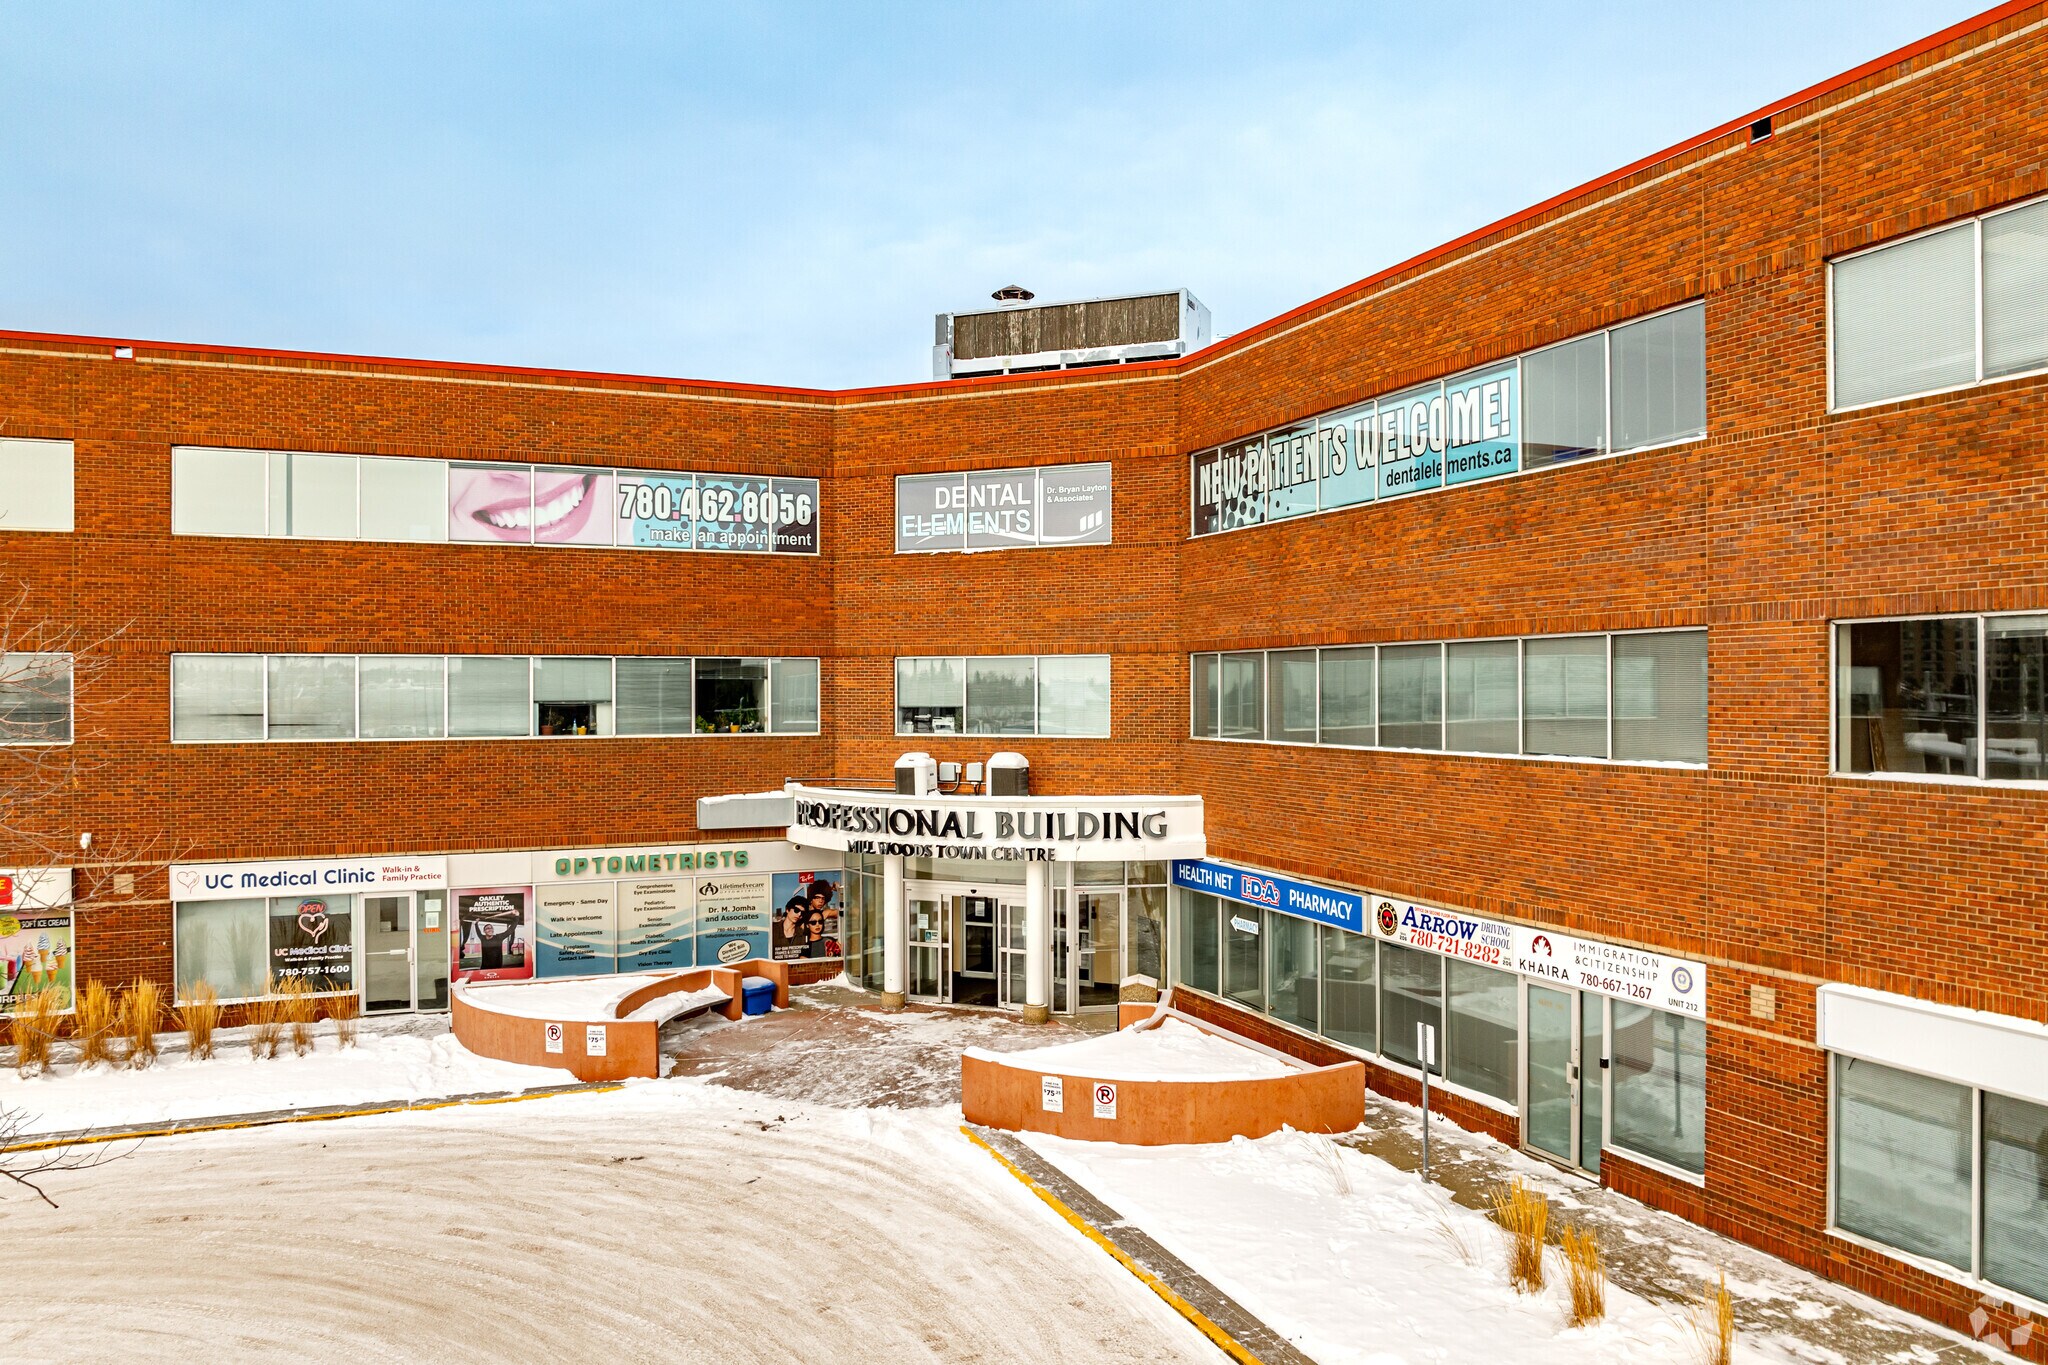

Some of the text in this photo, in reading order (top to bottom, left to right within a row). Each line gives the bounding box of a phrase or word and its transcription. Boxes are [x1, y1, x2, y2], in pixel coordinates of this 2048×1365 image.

[1200, 377, 1510, 507] NEW PATIENTS WELCOME!
[1386, 448, 1512, 487] dentalelements.ca
[935, 483, 1031, 509] DENTAL
[1047, 484, 1107, 494] Dr. Bryan Layton
[1053, 494, 1094, 503] Associates
[619, 483, 812, 526] 780.462.8056
[902, 510, 1030, 537] ELEMENTS
[651, 527, 812, 547] make an appointment
[796, 800, 984, 839] PROFESSIONAL
[994, 810, 1168, 840] BUILDING
[878, 841, 933, 858] WOODS
[935, 844, 987, 860] TOWN
[991, 846, 1056, 861] CENTRE
[555, 851, 749, 876] OPTOMETRISTS
[205, 868, 376, 889] UC Medical Clinic
[382, 872, 442, 882] Family Practice
[1179, 864, 1234, 891] HEALTH NET
[300, 904, 325, 913] OPEN
[469, 904, 514, 912] PRESCRIPTION
[1289, 889, 1353, 921] PHARMACY
[22, 920, 36, 929] SOFT
[1234, 918, 1259, 933] PHARMACY
[1401, 906, 1478, 940] ARROW
[1481, 922, 1510, 937] DRIVING
[275, 944, 353, 956] UC Medical Clinic
[1410, 929, 1500, 964] 780-721-8282
[1481, 934, 1510, 950] SCHOOL
[1574, 942, 1659, 968] IMMIGRATION
[279, 965, 350, 977] 780-757-1600
[1519, 958, 1569, 980] KHAIRA
[1580, 972, 1652, 1000] 780-667-1267
[1668, 998, 1698, 1011] UNIT 212
